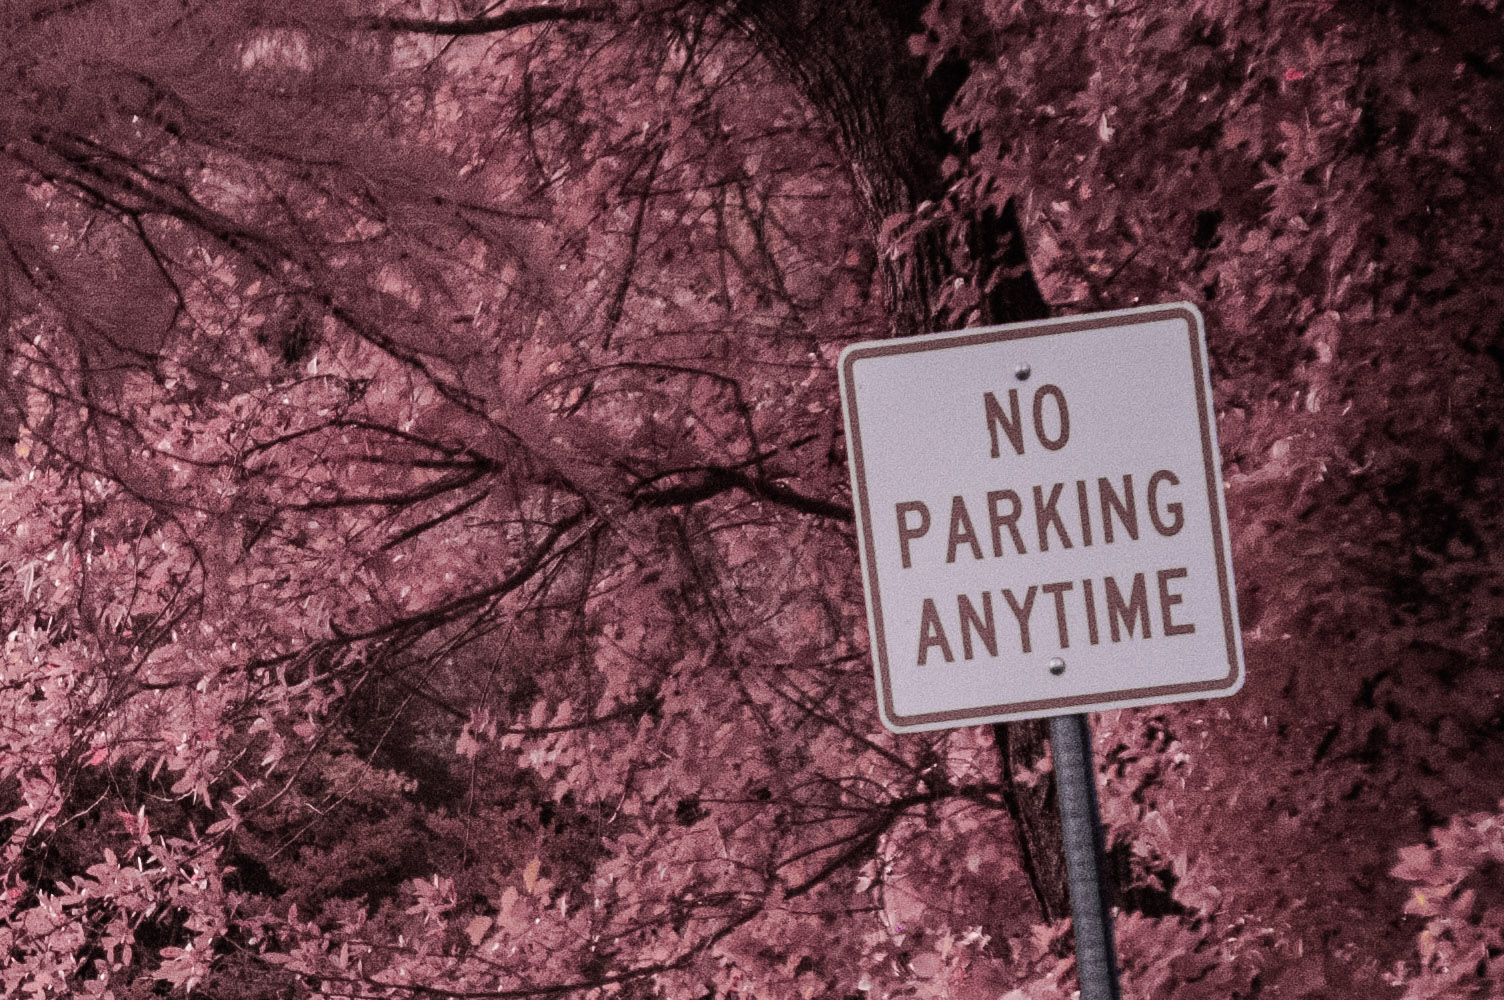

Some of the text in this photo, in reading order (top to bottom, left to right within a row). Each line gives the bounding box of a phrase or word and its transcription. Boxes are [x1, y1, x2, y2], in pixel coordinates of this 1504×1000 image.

[983, 383, 1071, 459] NO
[895, 469, 1185, 569] PARKING
[916, 567, 1196, 666] ANYTIME
